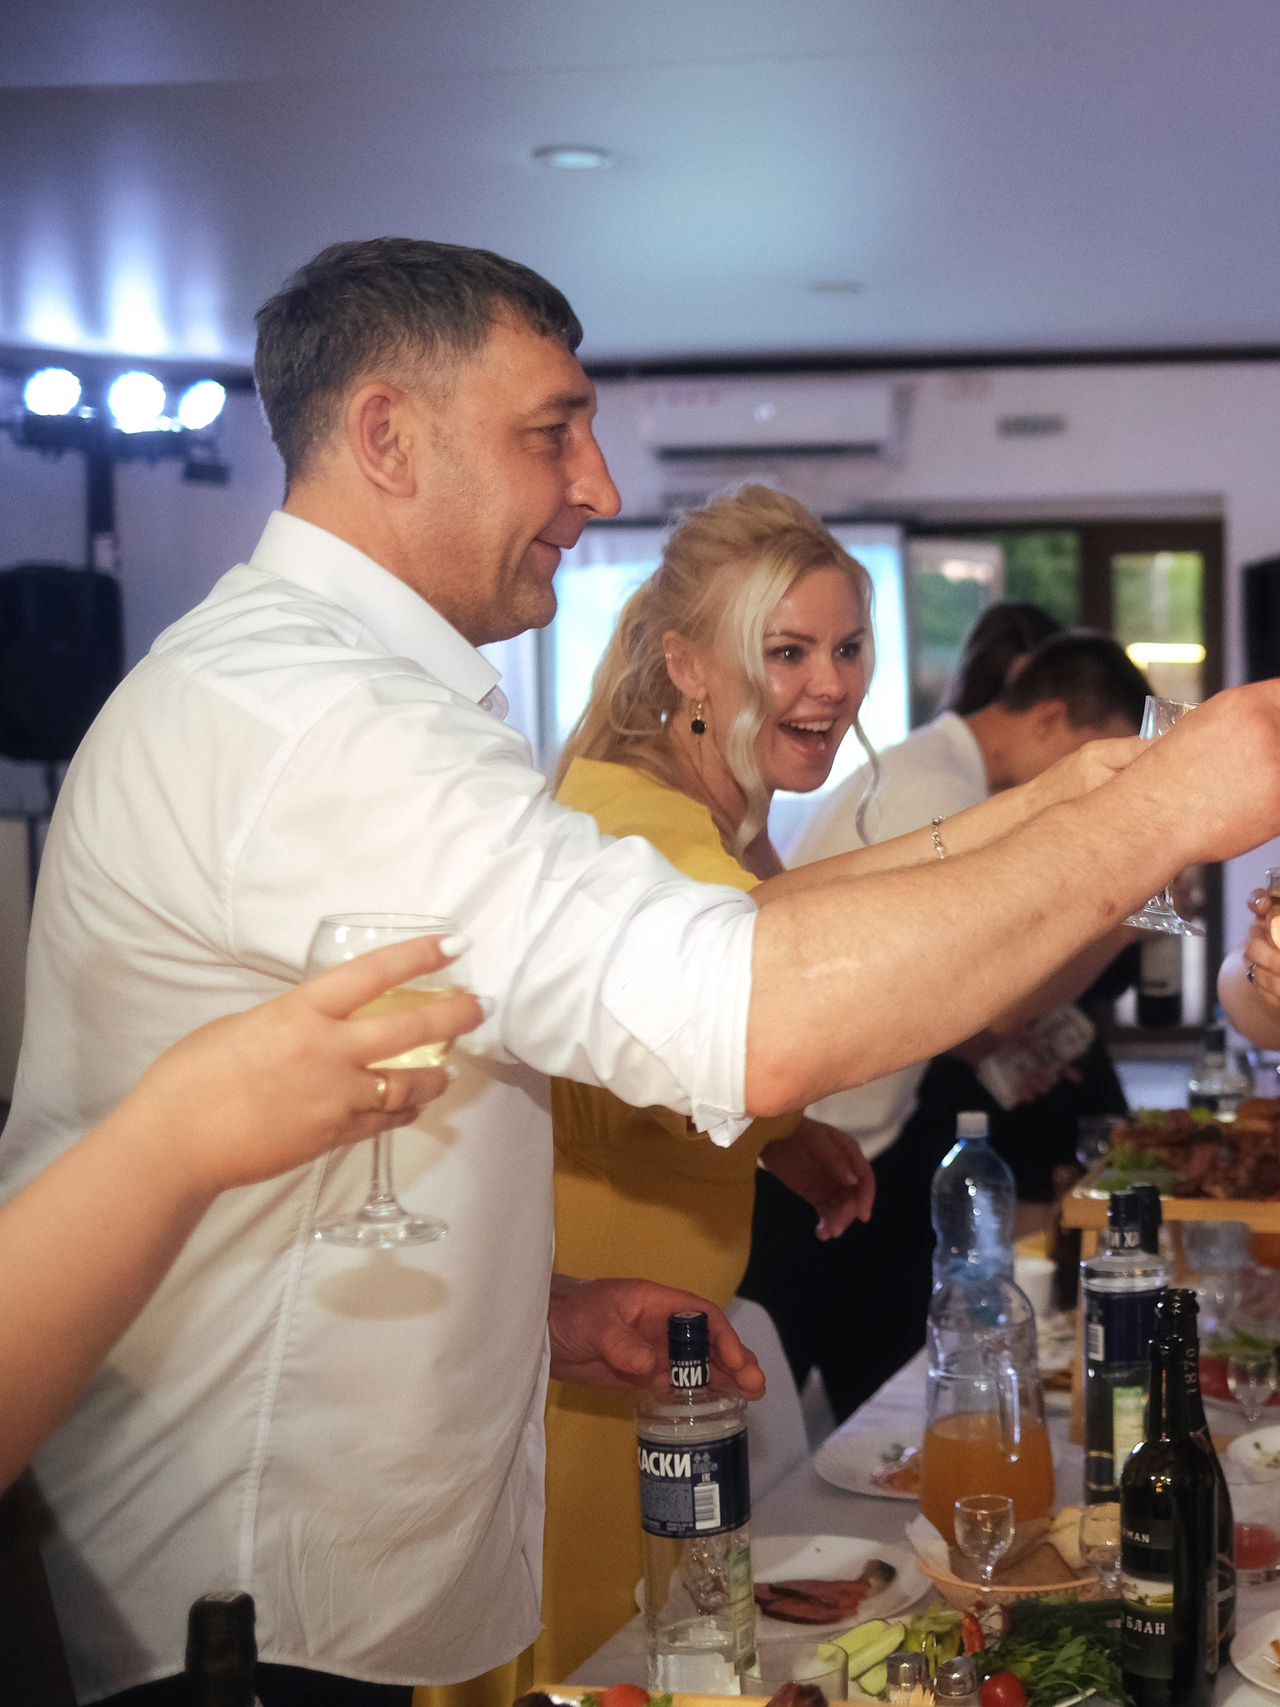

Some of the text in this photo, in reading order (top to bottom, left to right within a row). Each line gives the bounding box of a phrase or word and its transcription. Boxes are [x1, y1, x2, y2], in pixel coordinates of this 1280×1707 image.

[670, 1365, 703, 1387] СКИ
[1183, 1347, 1198, 1394] 1870
[1126, 1616, 1166, 1636] БЛАН
